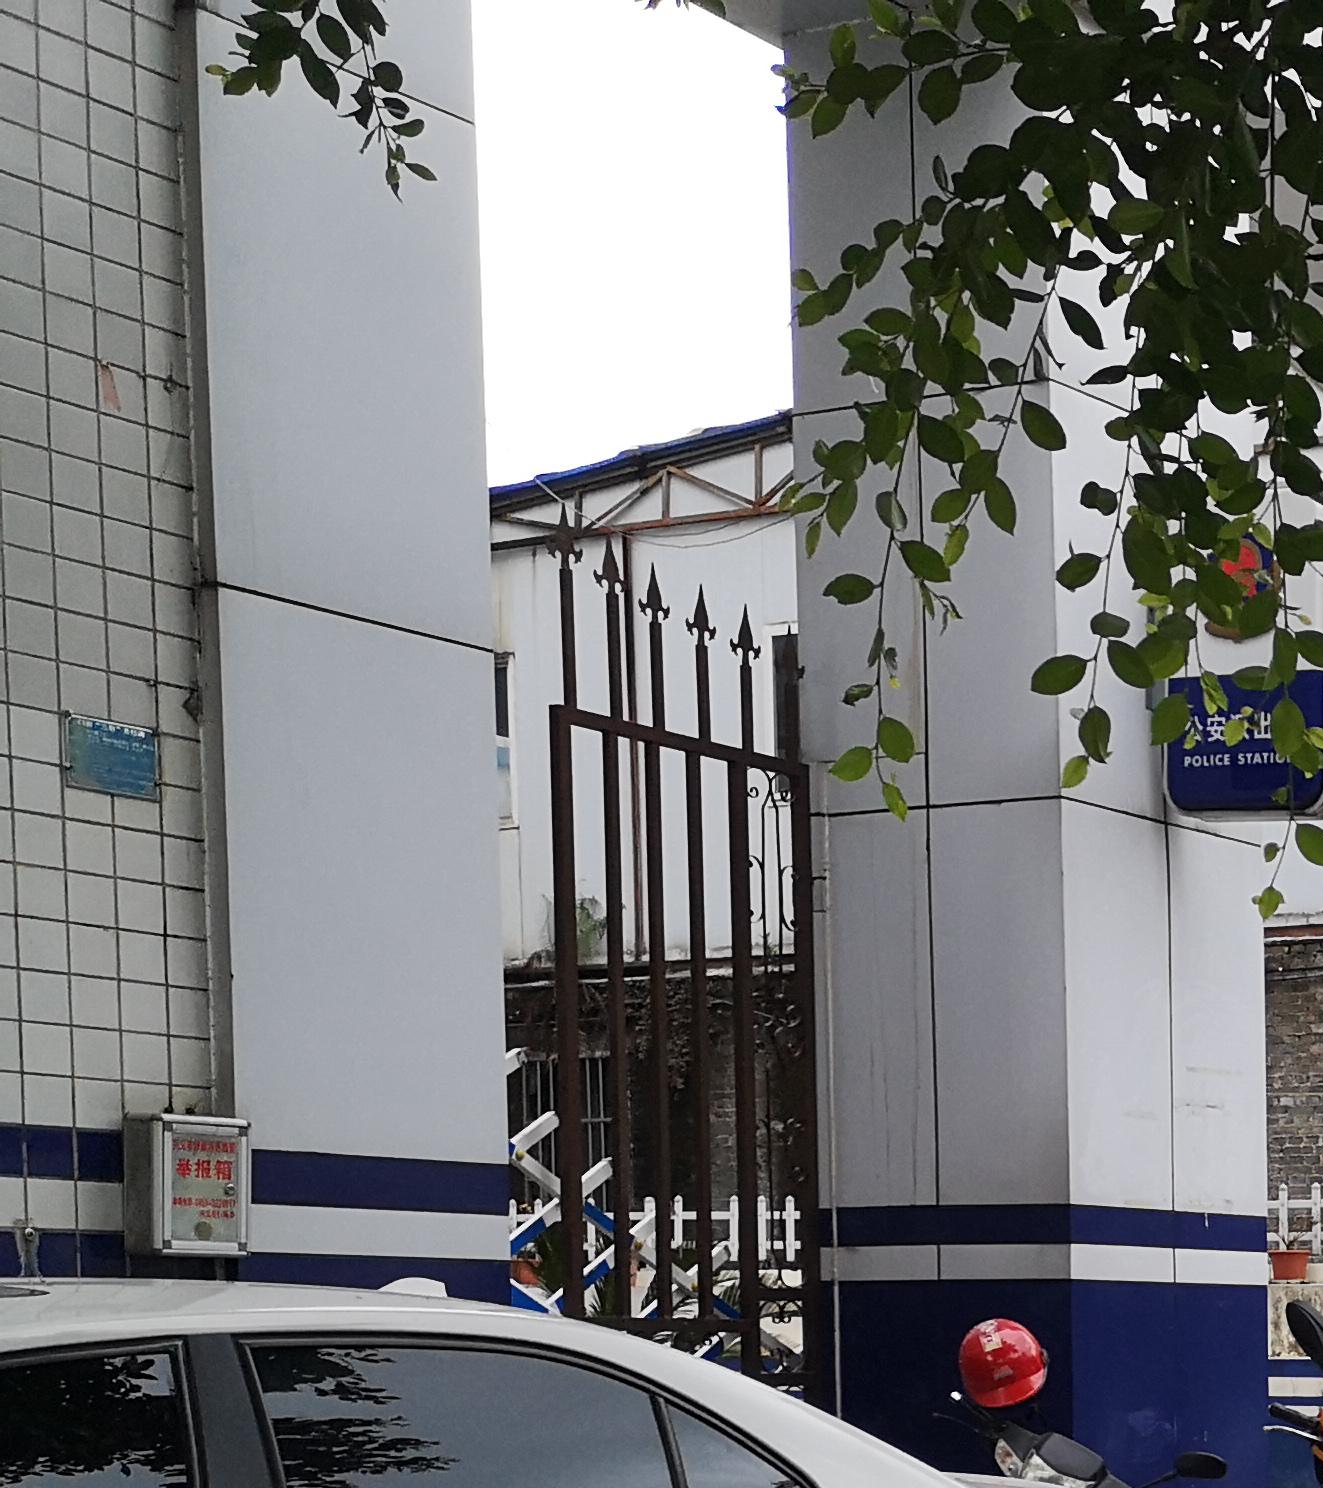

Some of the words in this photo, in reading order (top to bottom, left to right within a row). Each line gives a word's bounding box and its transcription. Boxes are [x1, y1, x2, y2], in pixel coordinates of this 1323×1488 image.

[1184, 711, 1272, 742] 公安出
[1184, 754, 1231, 768] POLICE
[1238, 752, 1291, 765] STATIO
[176, 1158, 233, 1181] 举报箱
